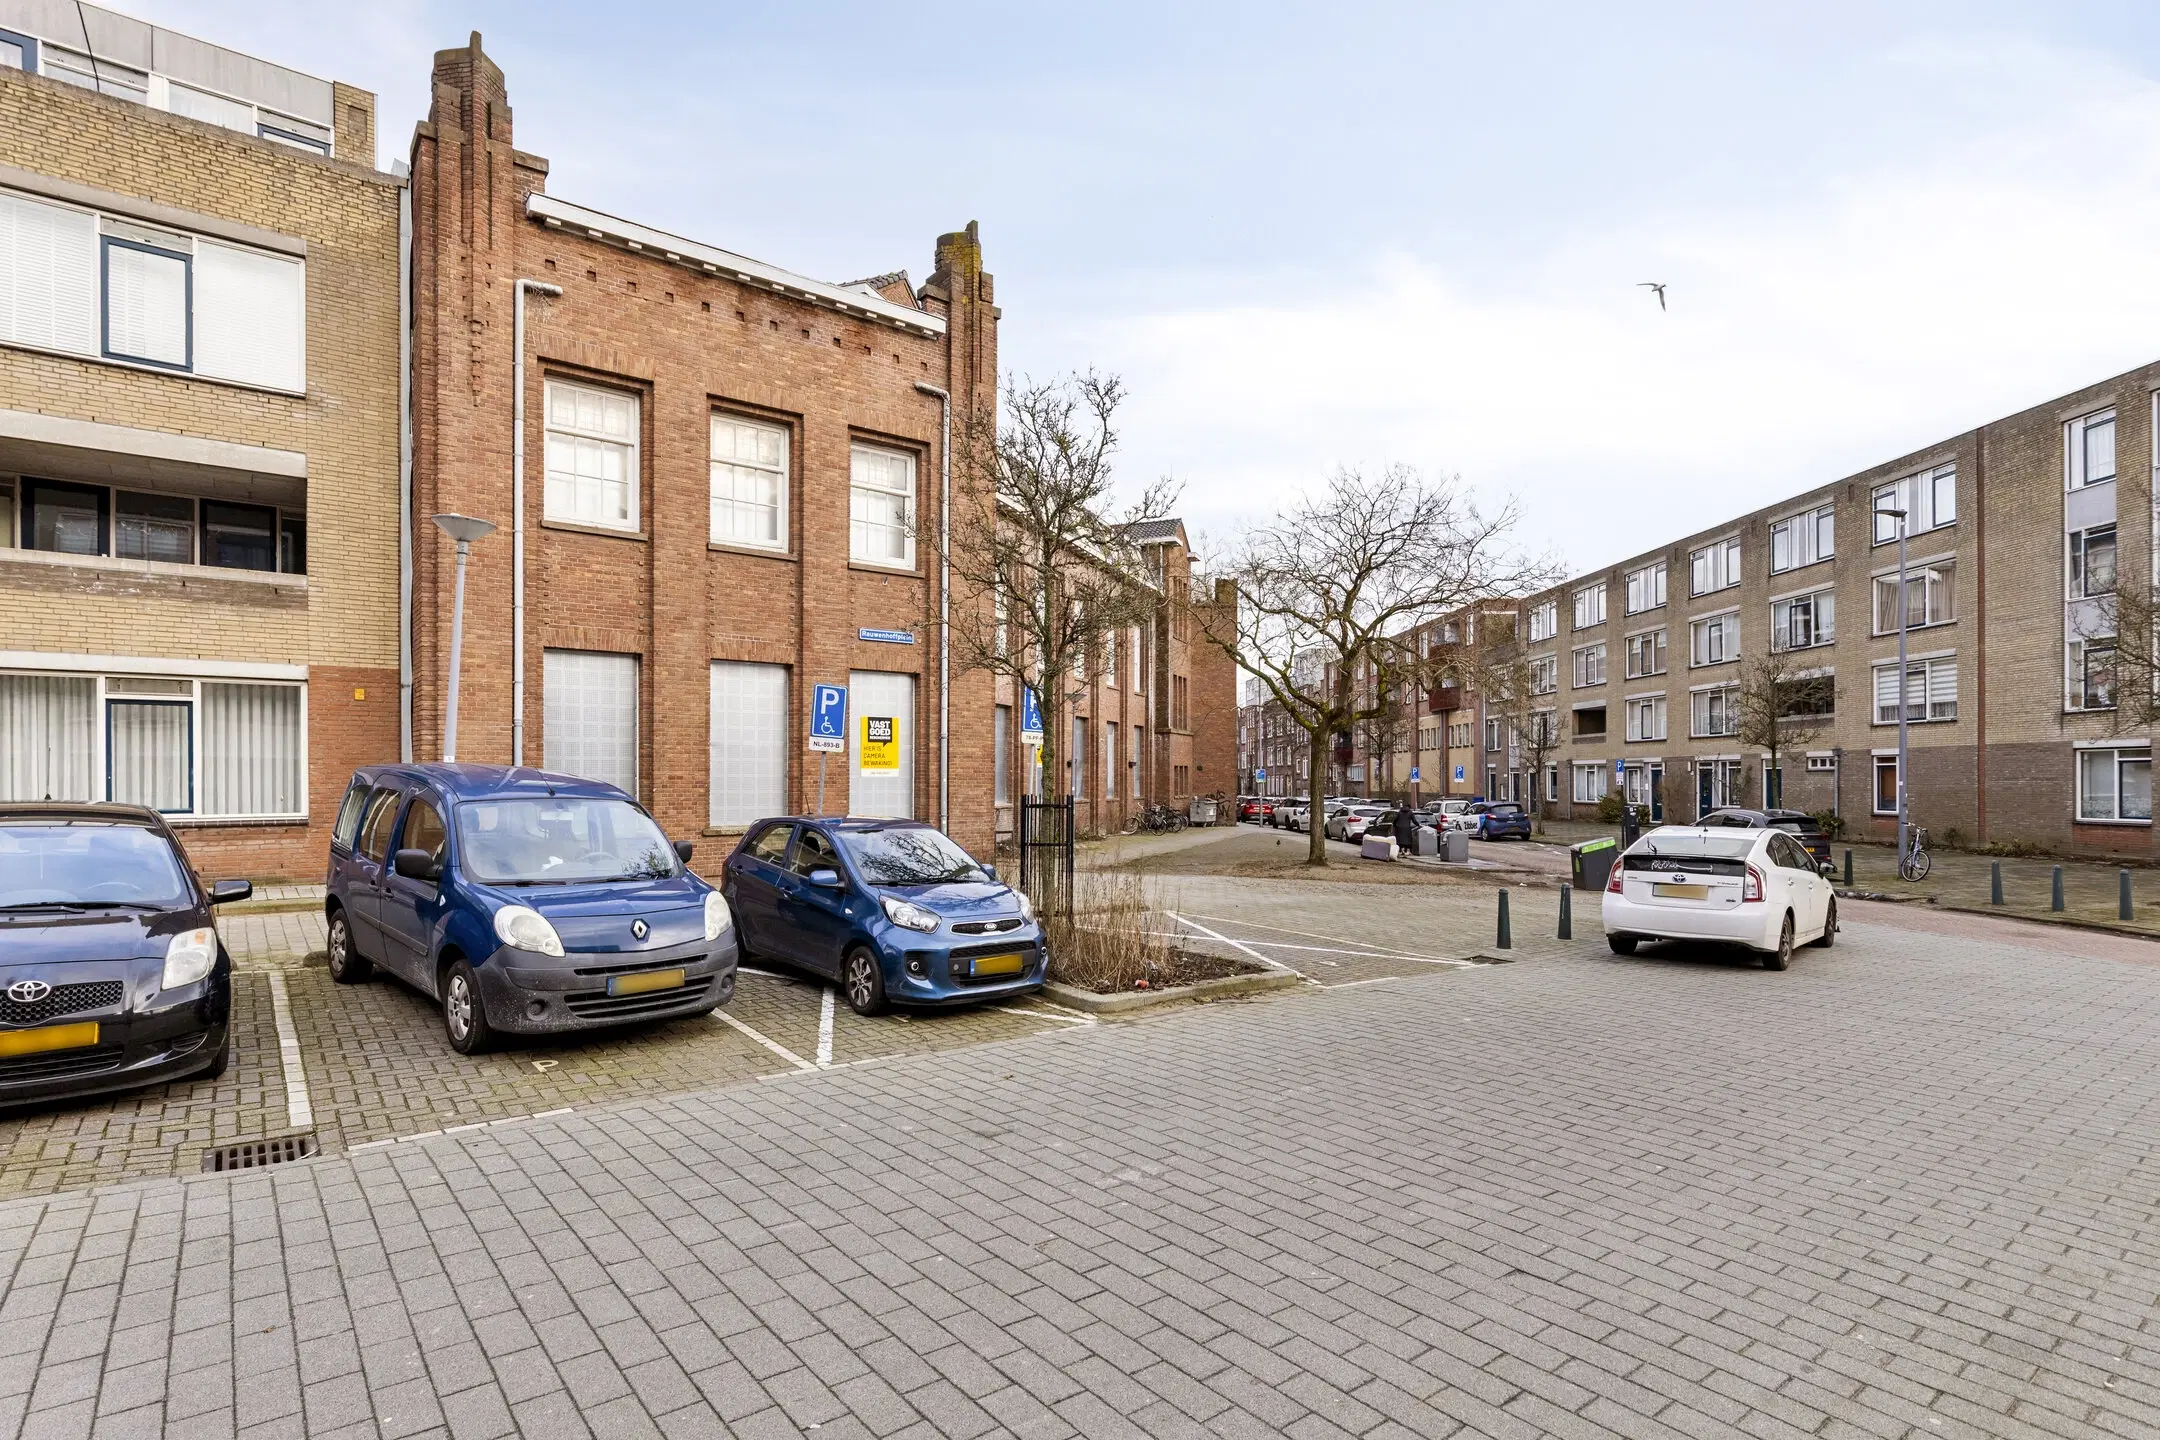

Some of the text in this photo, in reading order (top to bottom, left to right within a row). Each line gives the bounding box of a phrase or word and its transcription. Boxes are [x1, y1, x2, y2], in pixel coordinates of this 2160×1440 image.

[821, 688, 840, 715] P
[870, 720, 891, 729] VAST
[869, 728, 891, 736] GOED
[813, 741, 840, 749] NL-893-B
[1464, 821, 1478, 830] Zibber
[531, 1060, 559, 1072] P
